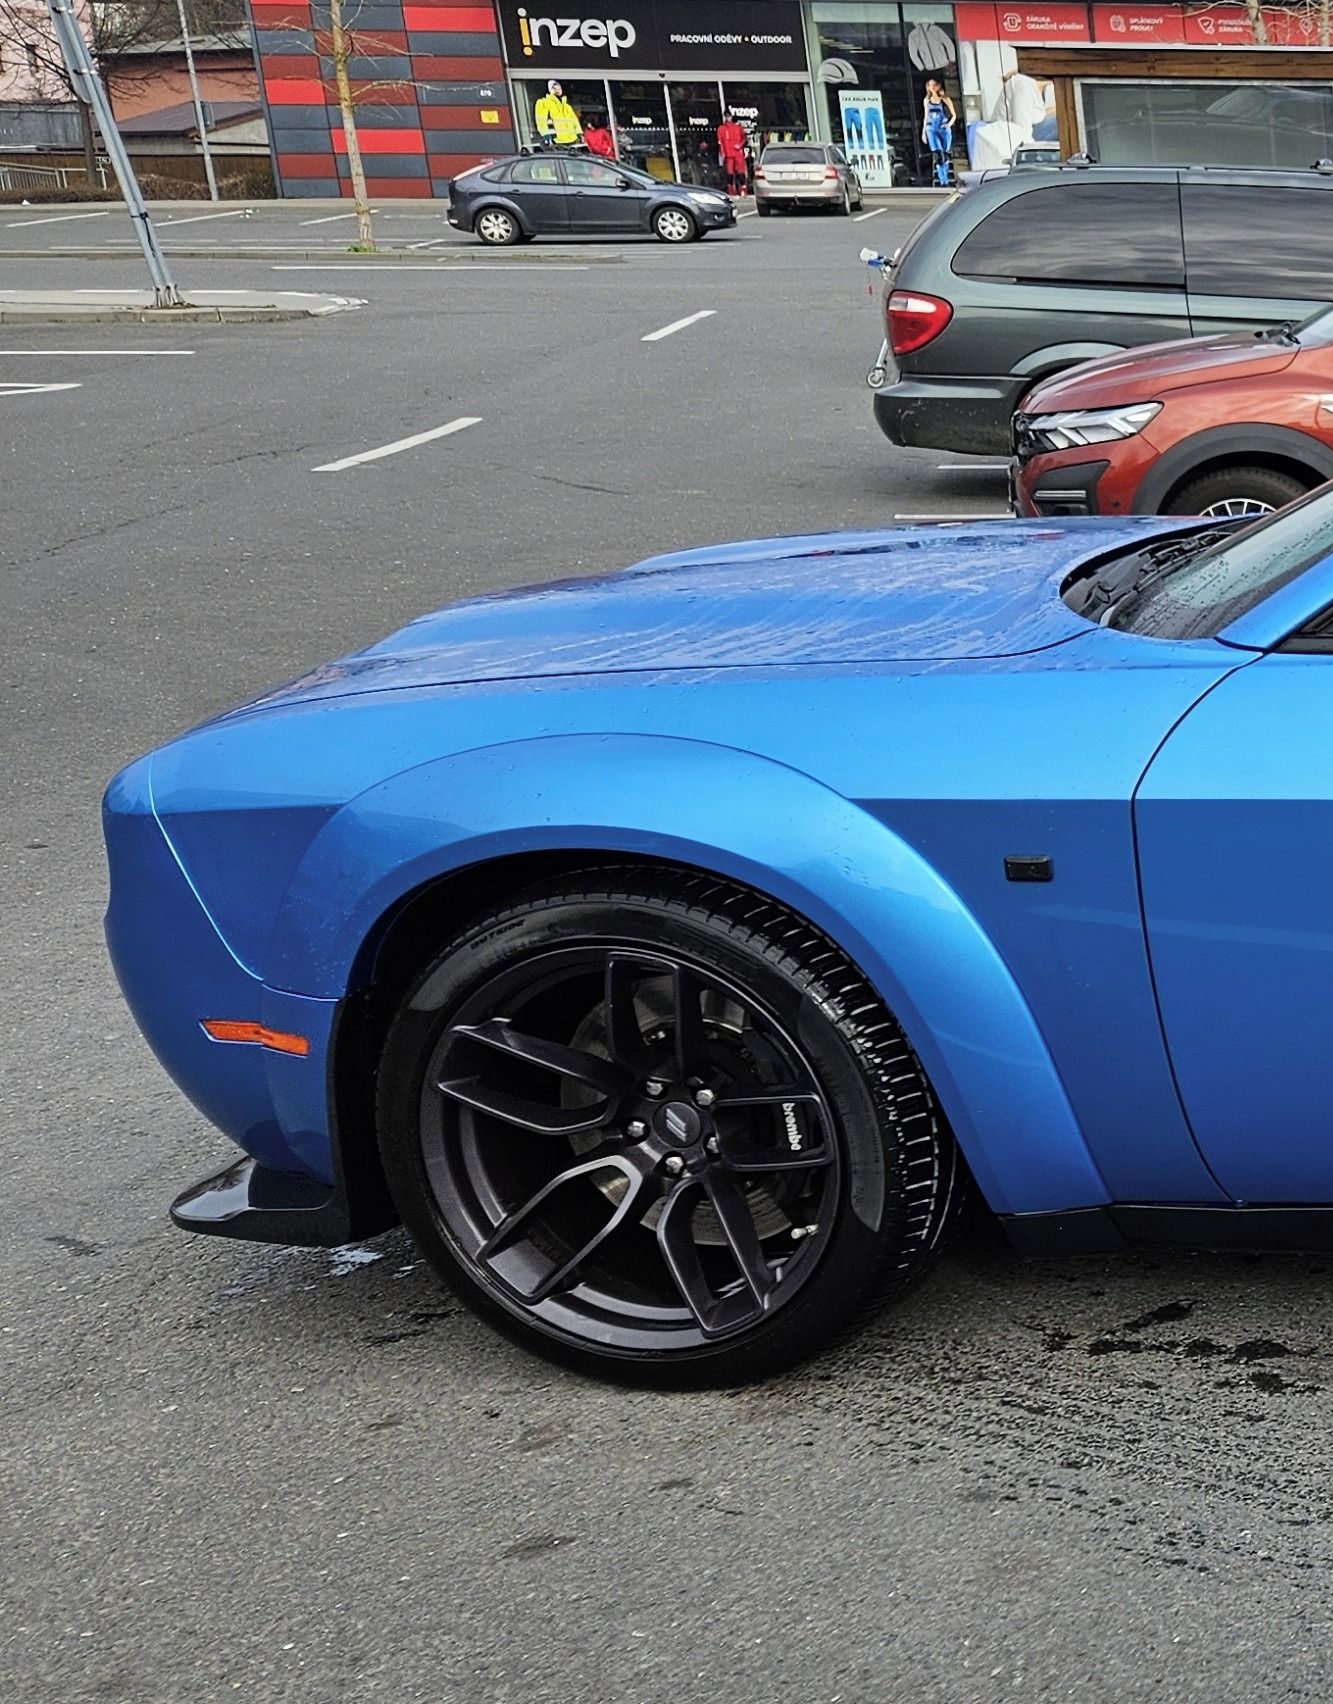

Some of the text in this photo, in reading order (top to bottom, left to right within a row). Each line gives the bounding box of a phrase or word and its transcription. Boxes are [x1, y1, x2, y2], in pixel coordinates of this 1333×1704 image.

[517, 7, 637, 58] inzep
[750, 35, 793, 43] OUTDOOR
[782, 1103, 801, 1151] brembo
